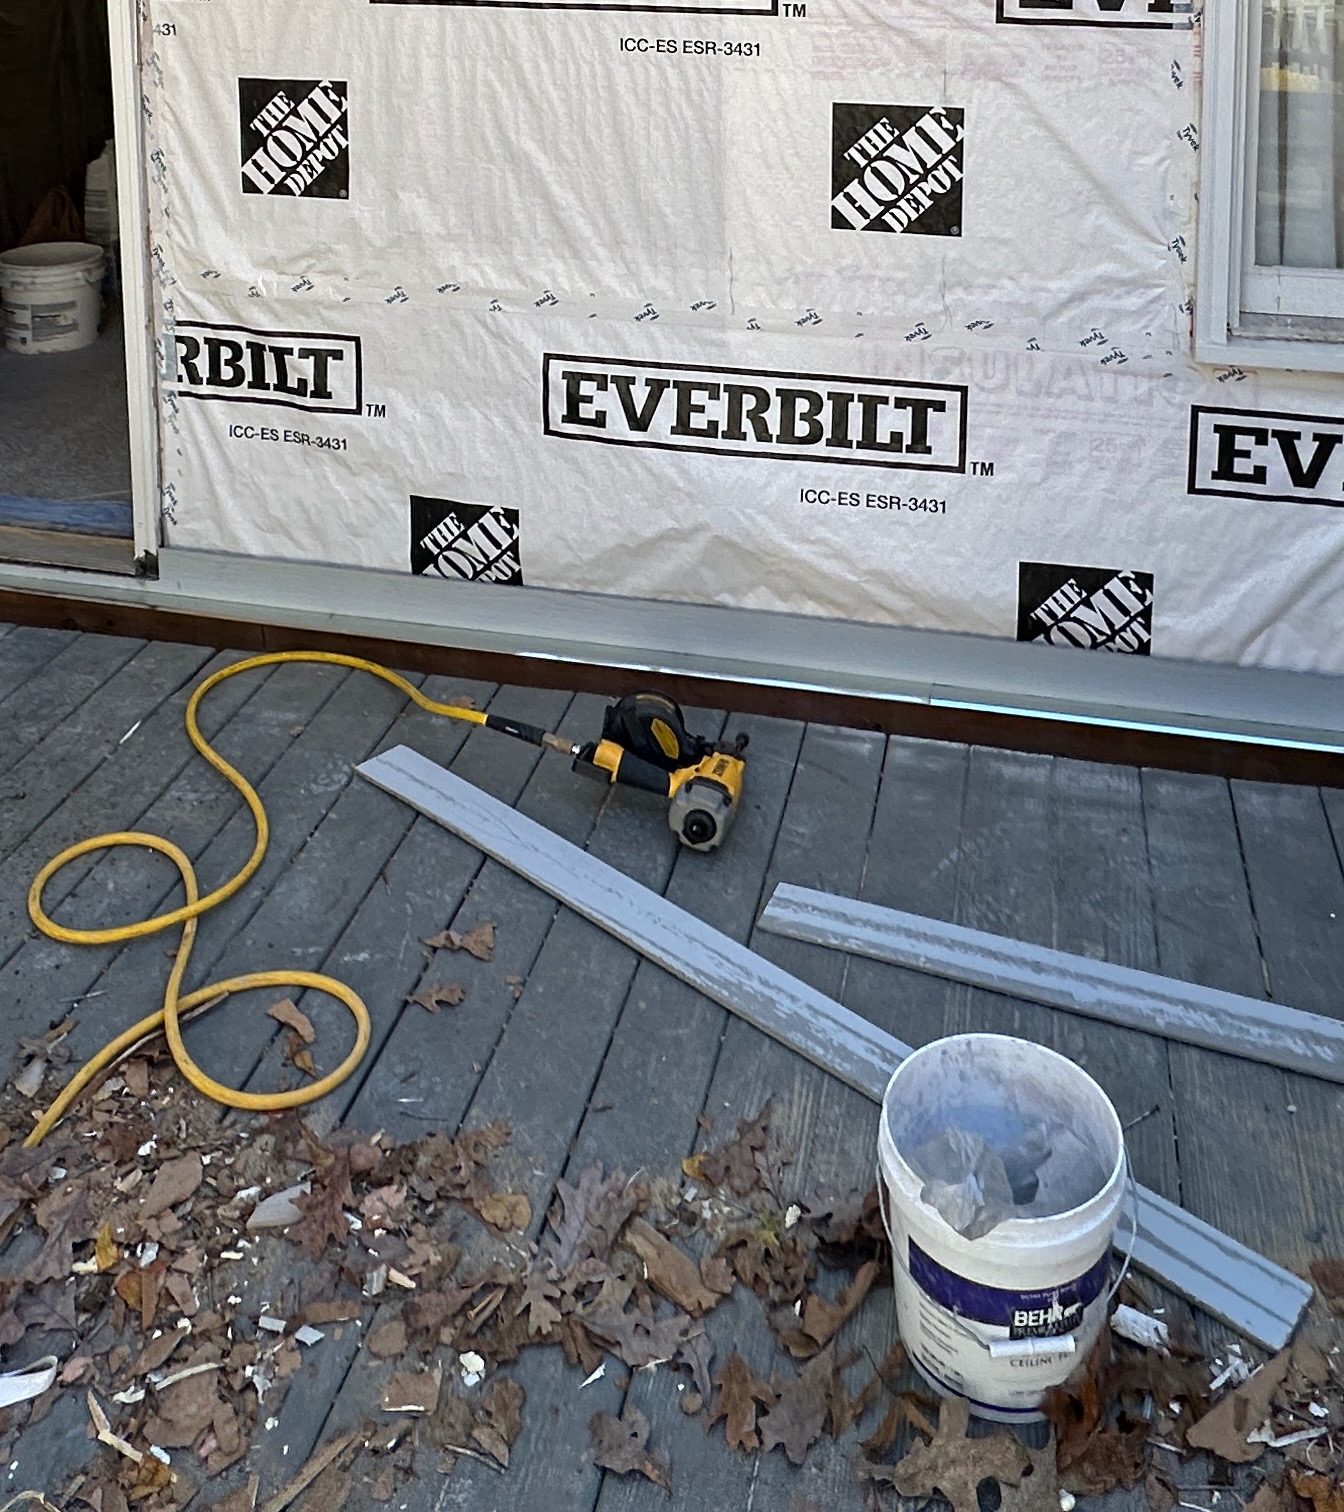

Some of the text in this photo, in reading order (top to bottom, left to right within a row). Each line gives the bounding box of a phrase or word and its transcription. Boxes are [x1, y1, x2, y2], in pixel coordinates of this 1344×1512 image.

[782, 3, 807, 18] TM
[619, 37, 762, 57] ICC-ES ESR-3431
[249, 90, 296, 138] THE
[240, 80, 349, 196] HOME
[283, 123, 349, 199] DEPOT
[842, 117, 899, 171] THE
[830, 105, 965, 232] HOME
[880, 154, 965, 235] DEPOT
[795, 311, 821, 327] Tyvek
[904, 327, 930, 343] Tyvek
[1079, 329, 1106, 348] Tyvek
[1100, 347, 1127, 366] Tyvek
[365, 403, 386, 418] TM
[561, 369, 947, 456] EVERBILT
[969, 460, 995, 478] TM
[228, 424, 349, 452] ICC-ES ESR-3431
[799, 489, 948, 515] ICC-ES ESR-3431
[419, 511, 466, 557] THE
[1029, 577, 1088, 627] THE
[1031, 569, 1154, 650] OME
